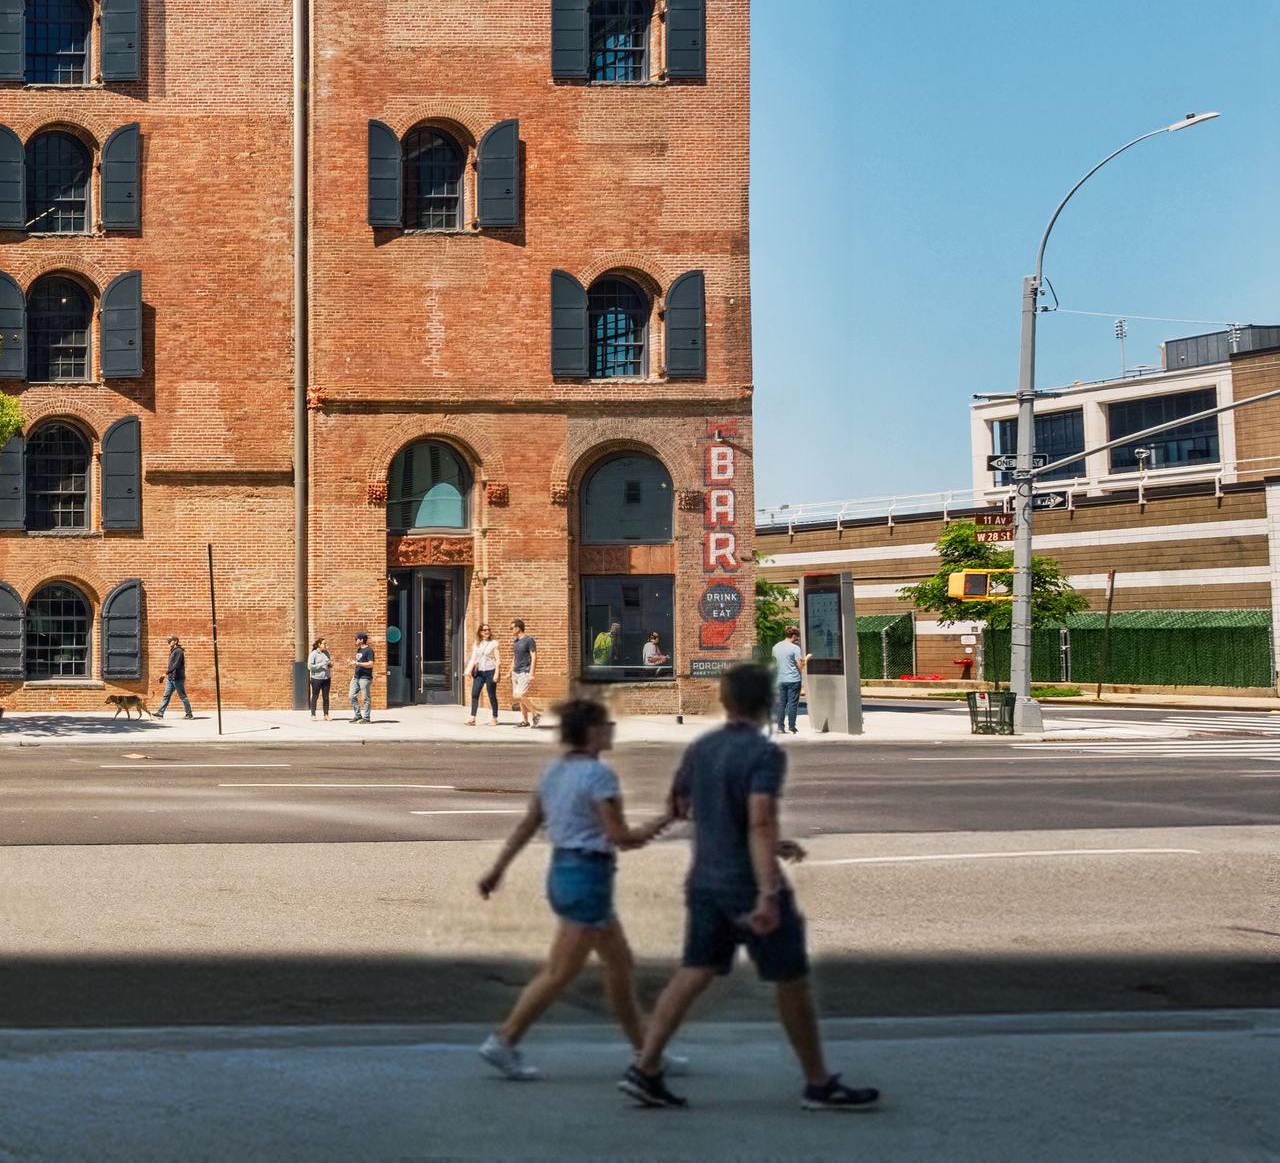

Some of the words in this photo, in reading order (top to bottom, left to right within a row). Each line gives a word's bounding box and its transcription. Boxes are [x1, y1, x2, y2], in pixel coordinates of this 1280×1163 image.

[1040, 497, 1057, 505] WAY
[707, 444, 738, 568] BAR
[983, 516, 992, 524] 11
[995, 516, 1006, 524] Av
[977, 533, 986, 541] W
[987, 533, 998, 541] 28
[1001, 531, 1010, 540] St
[706, 593, 737, 601] DRINK
[712, 609, 731, 617] EAT
